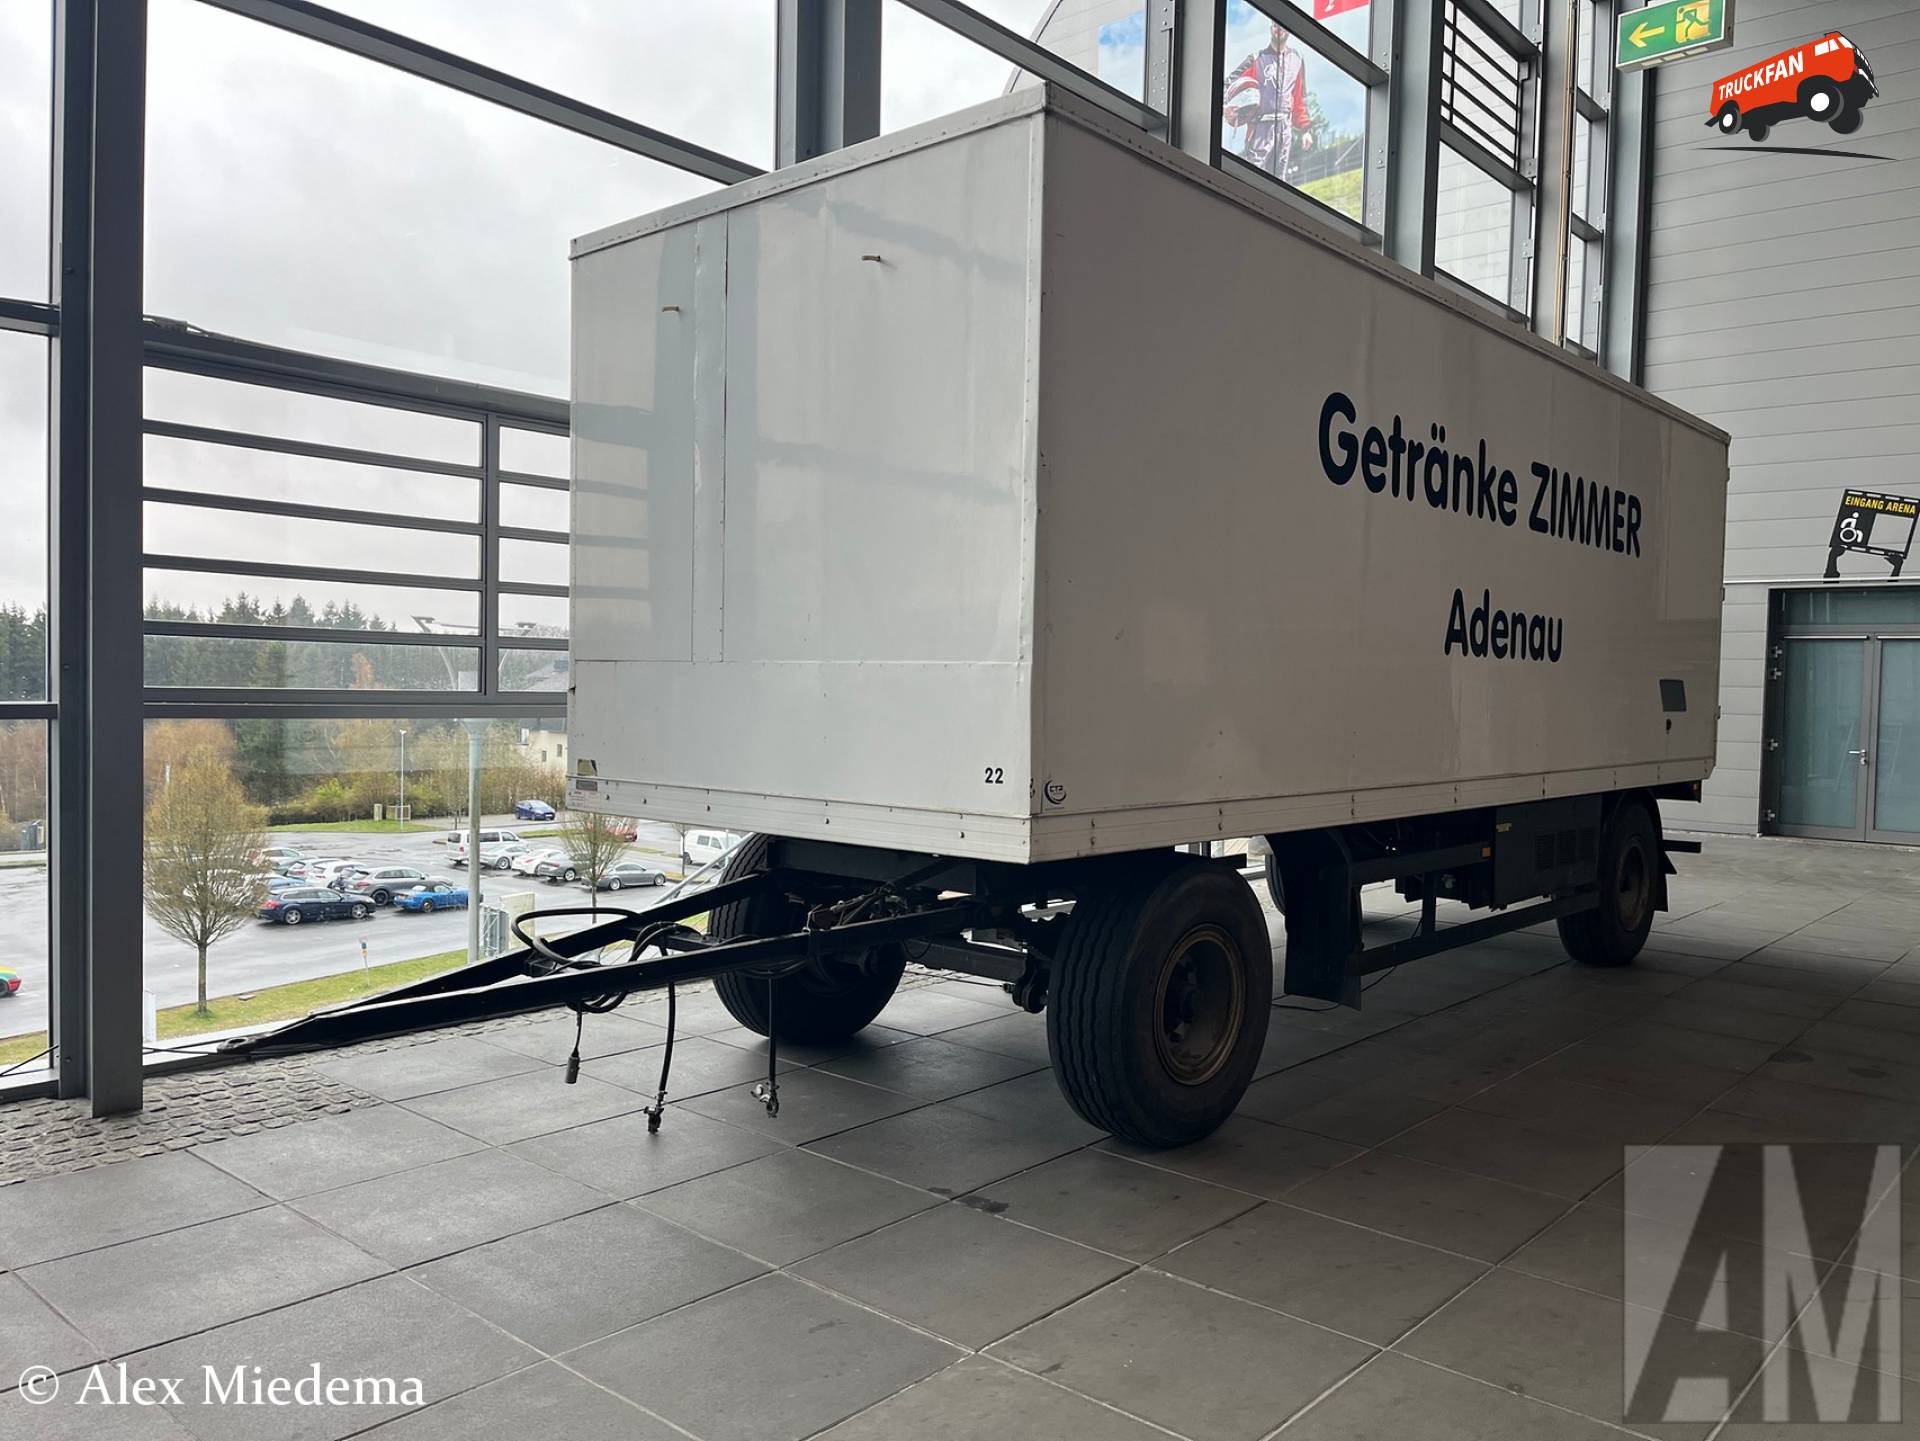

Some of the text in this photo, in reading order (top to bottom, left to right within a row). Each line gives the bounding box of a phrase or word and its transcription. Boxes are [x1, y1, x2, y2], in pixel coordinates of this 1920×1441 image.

[1318, 391, 1642, 558] Getränke ZIMMER
[1845, 496, 1916, 514] EINGANG ARENA
[1444, 588, 1563, 663] Adenau
[985, 767, 1004, 784] 22
